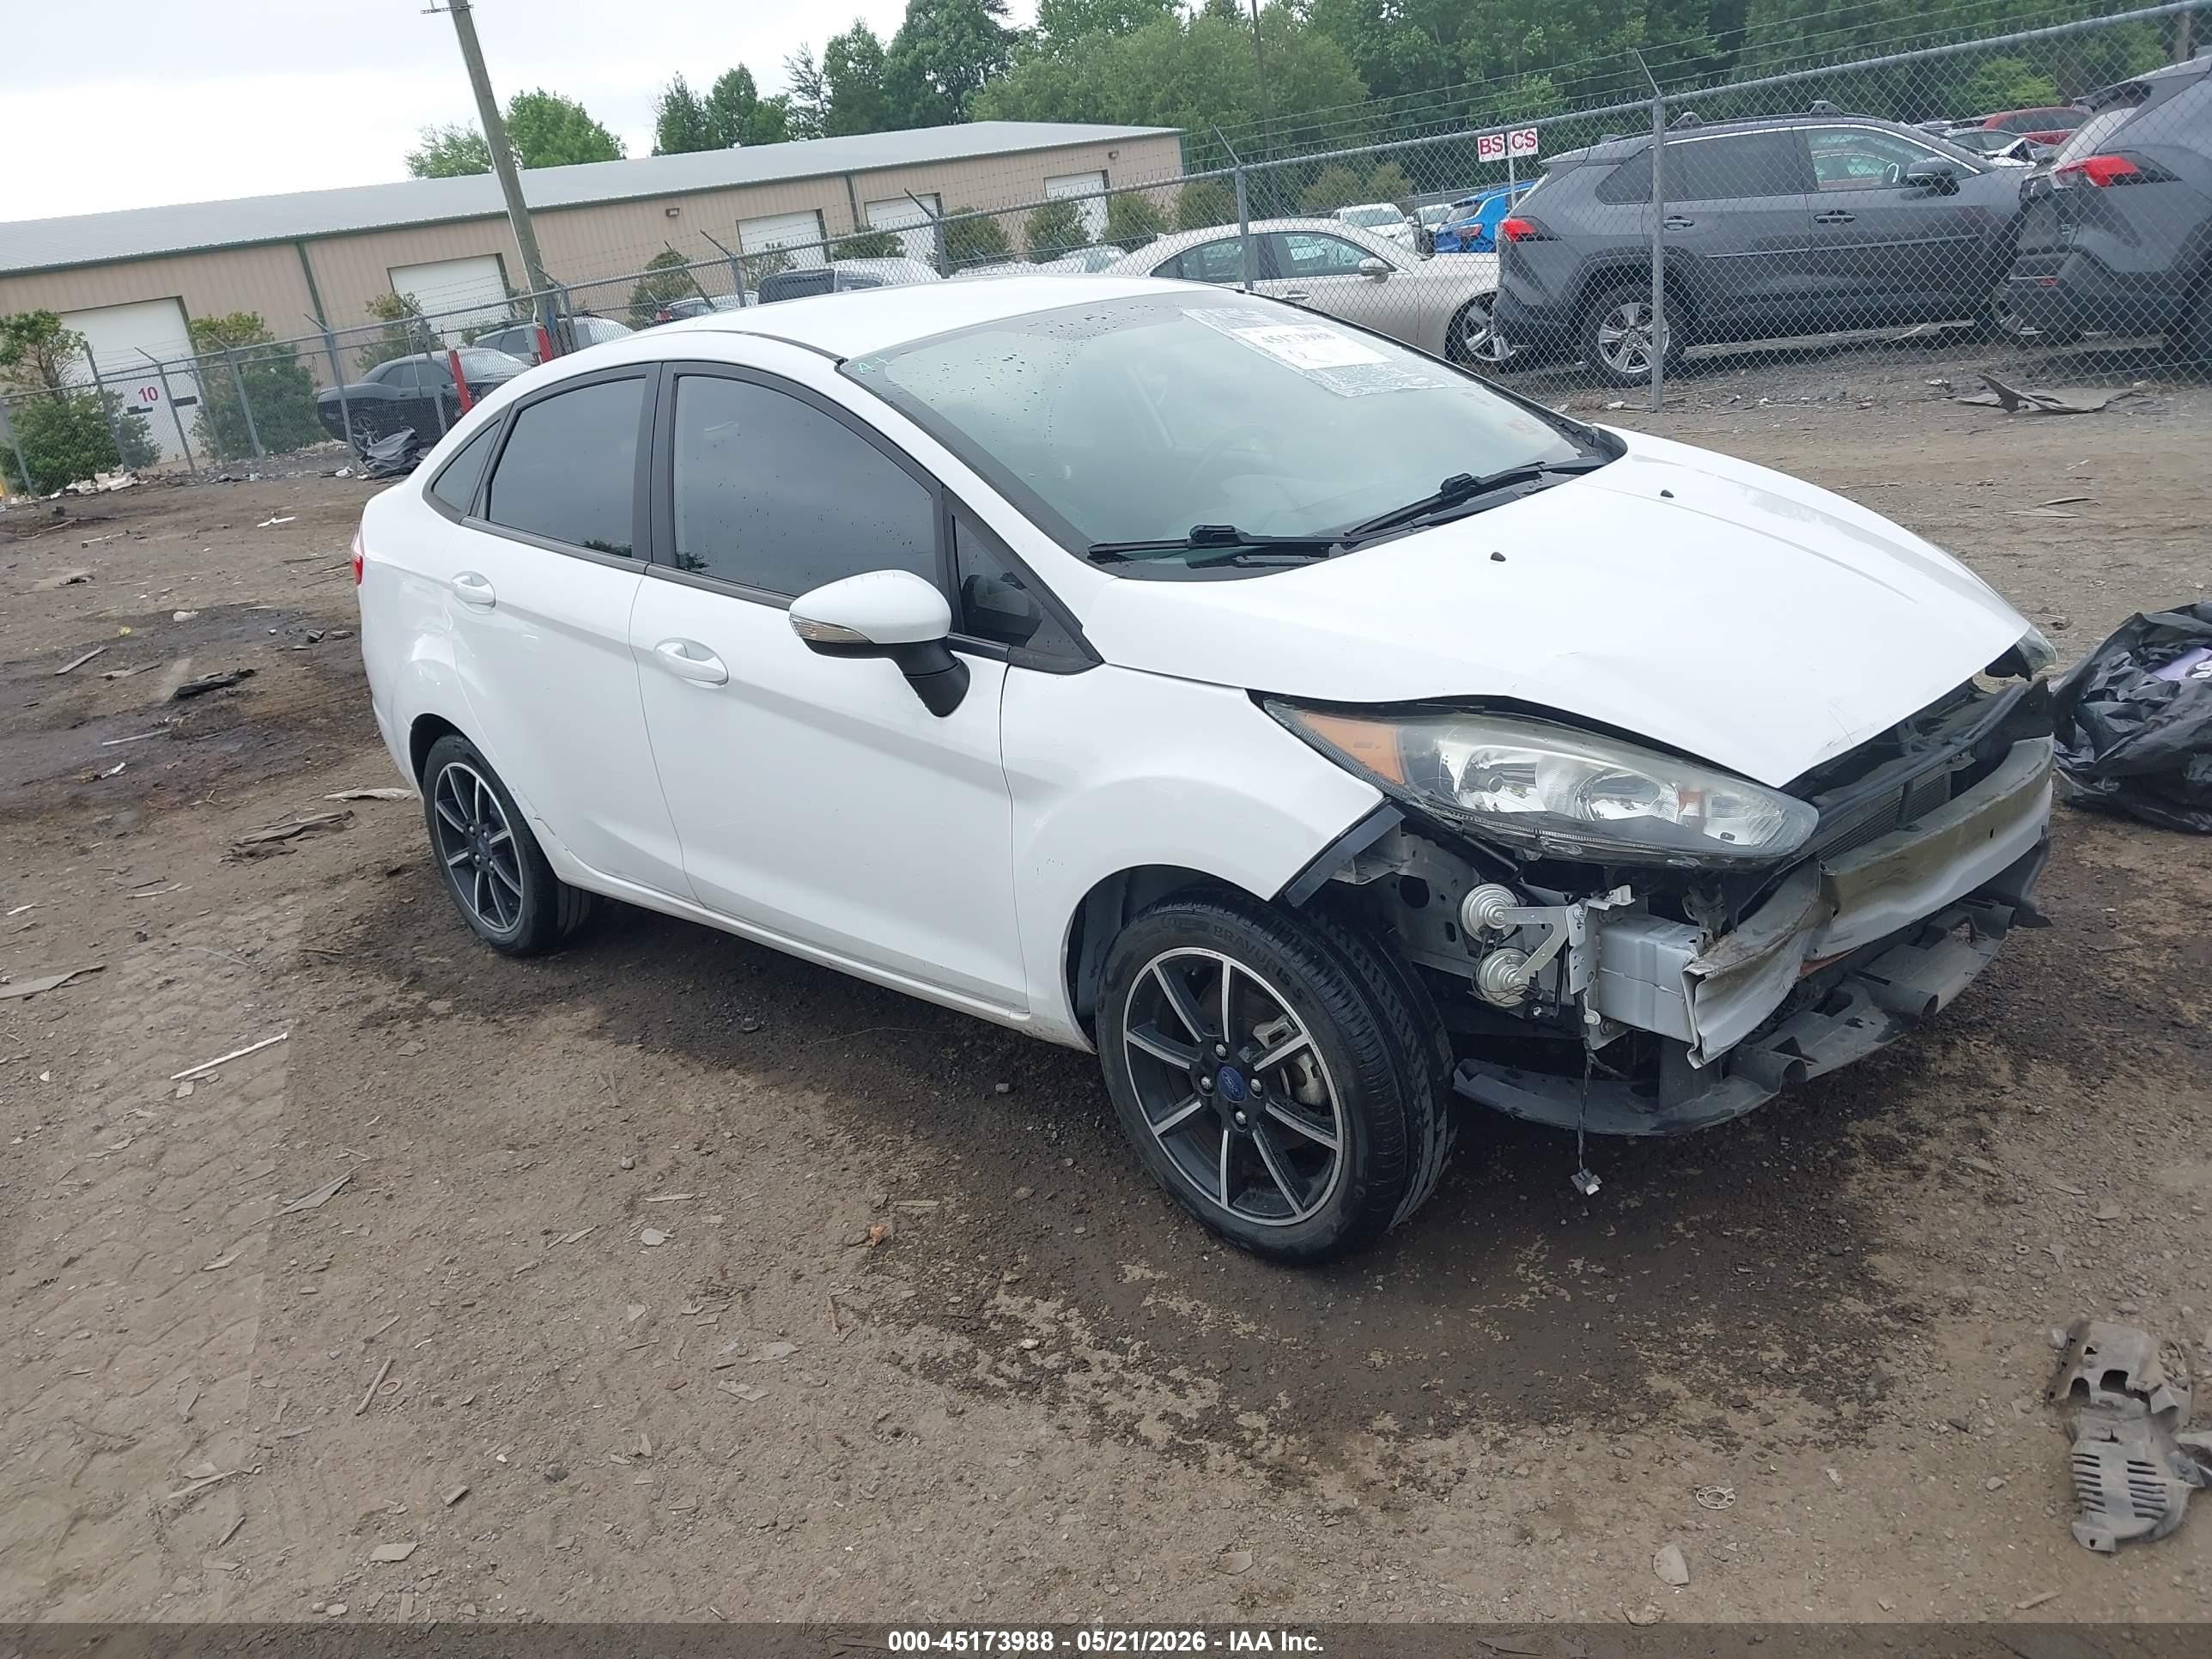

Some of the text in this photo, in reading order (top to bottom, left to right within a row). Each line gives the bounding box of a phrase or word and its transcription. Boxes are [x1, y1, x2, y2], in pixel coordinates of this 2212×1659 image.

[1480, 136, 1504, 155] BS
[1511, 131, 1536, 149] CS
[137, 386, 159, 403] 10
